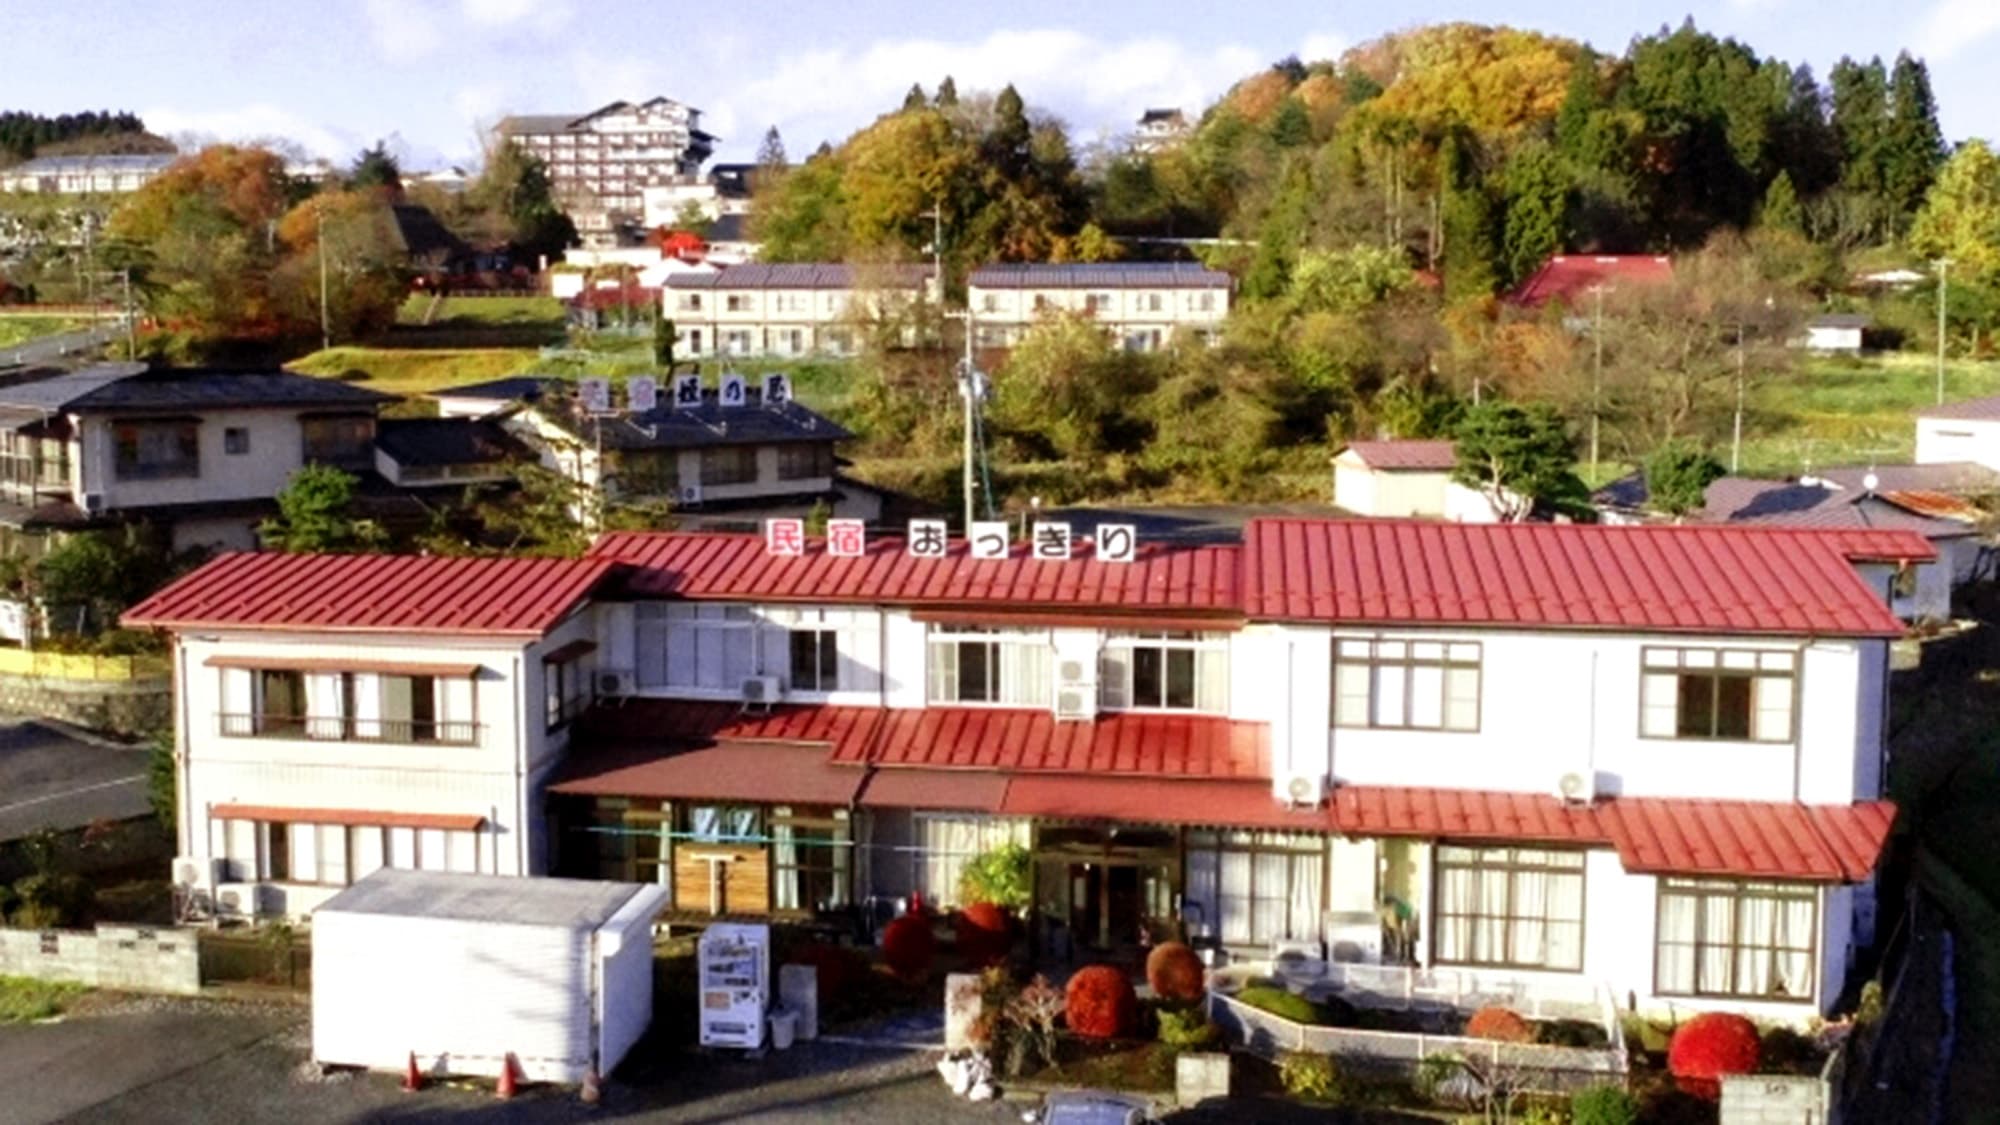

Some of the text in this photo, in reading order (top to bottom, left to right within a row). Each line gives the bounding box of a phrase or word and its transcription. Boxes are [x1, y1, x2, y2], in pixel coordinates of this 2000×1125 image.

[769, 520, 1134, 559] 民宿 おっきり
